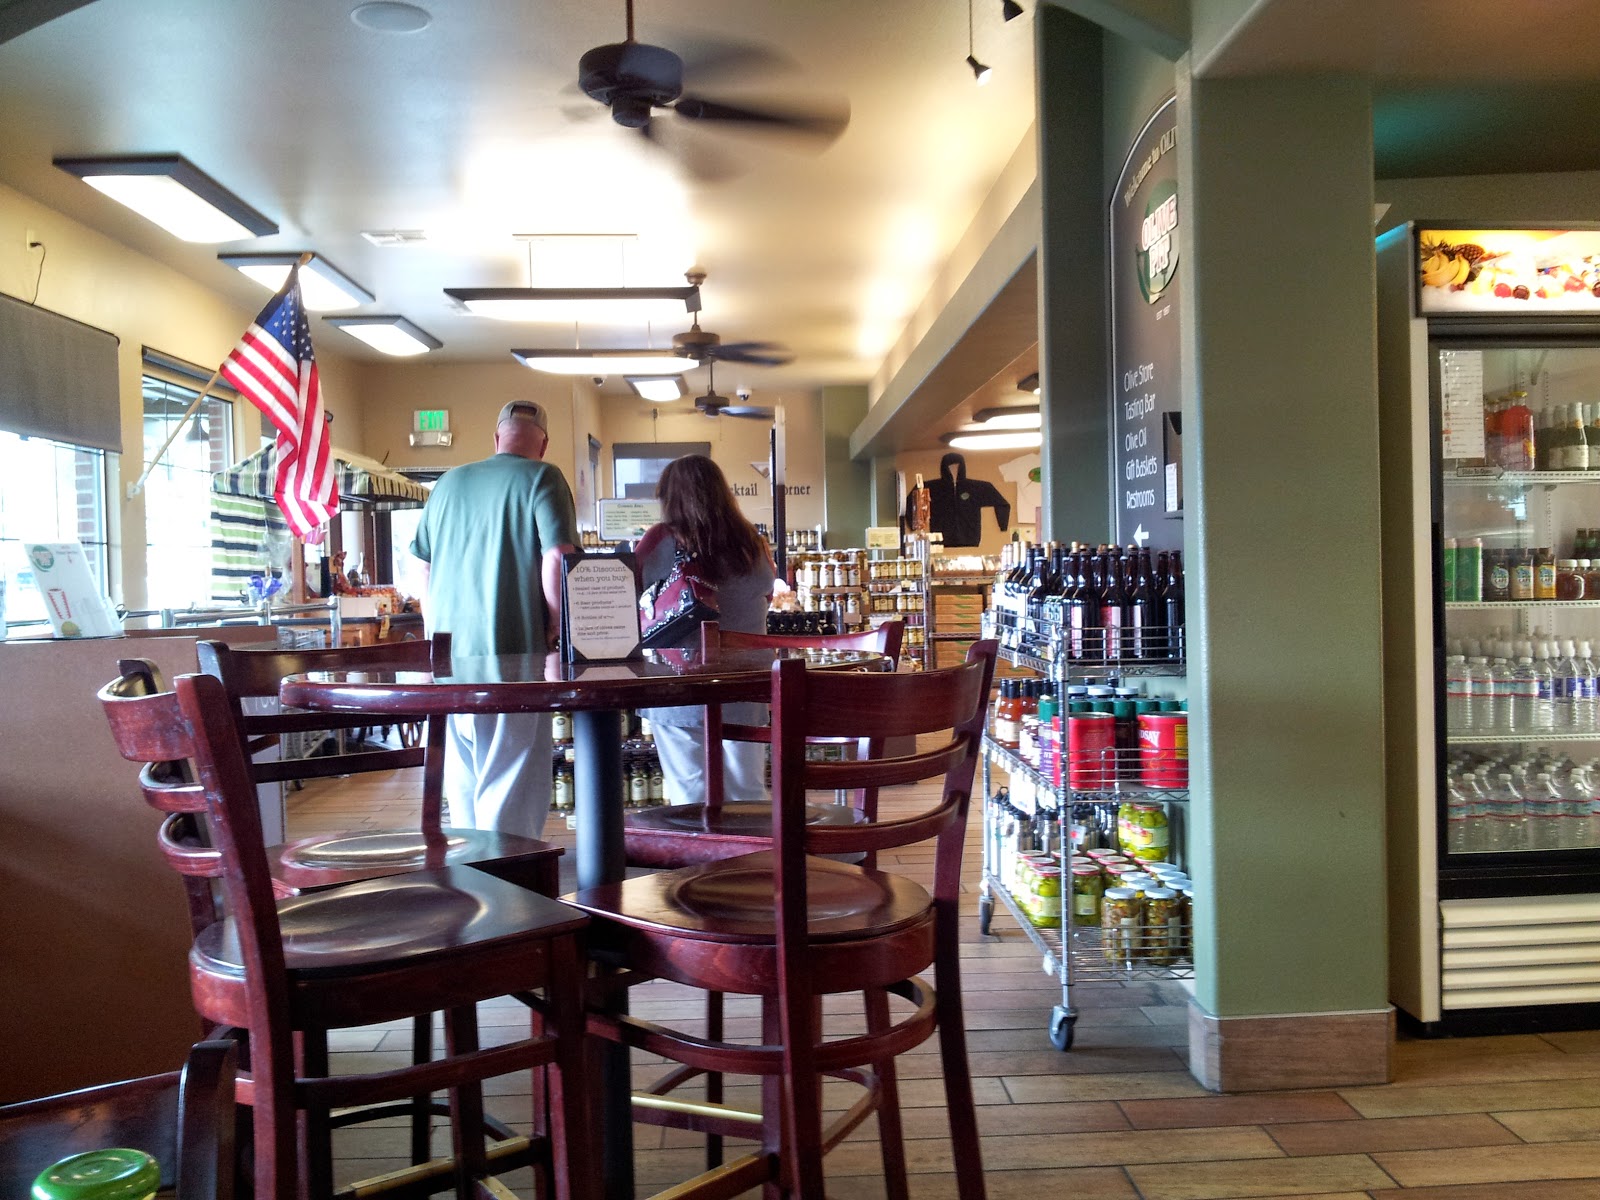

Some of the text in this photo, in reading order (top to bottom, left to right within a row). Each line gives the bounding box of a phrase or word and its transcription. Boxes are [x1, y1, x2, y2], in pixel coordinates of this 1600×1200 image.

[1160, 125, 1178, 156] OLI
[1142, 194, 1178, 251] OLIVE
[1124, 362, 1154, 392] Olive Store
[1125, 393, 1156, 420] Tasting Bar
[419, 410, 445, 431] EXIT
[1125, 426, 1147, 452] Olive Oil
[1126, 455, 1158, 480] Gift Baskets
[784, 484, 811, 496] orner
[1126, 489, 1155, 509] Restrooms
[576, 565, 627, 574] 10% Discount
[612, 574, 626, 582] buy
